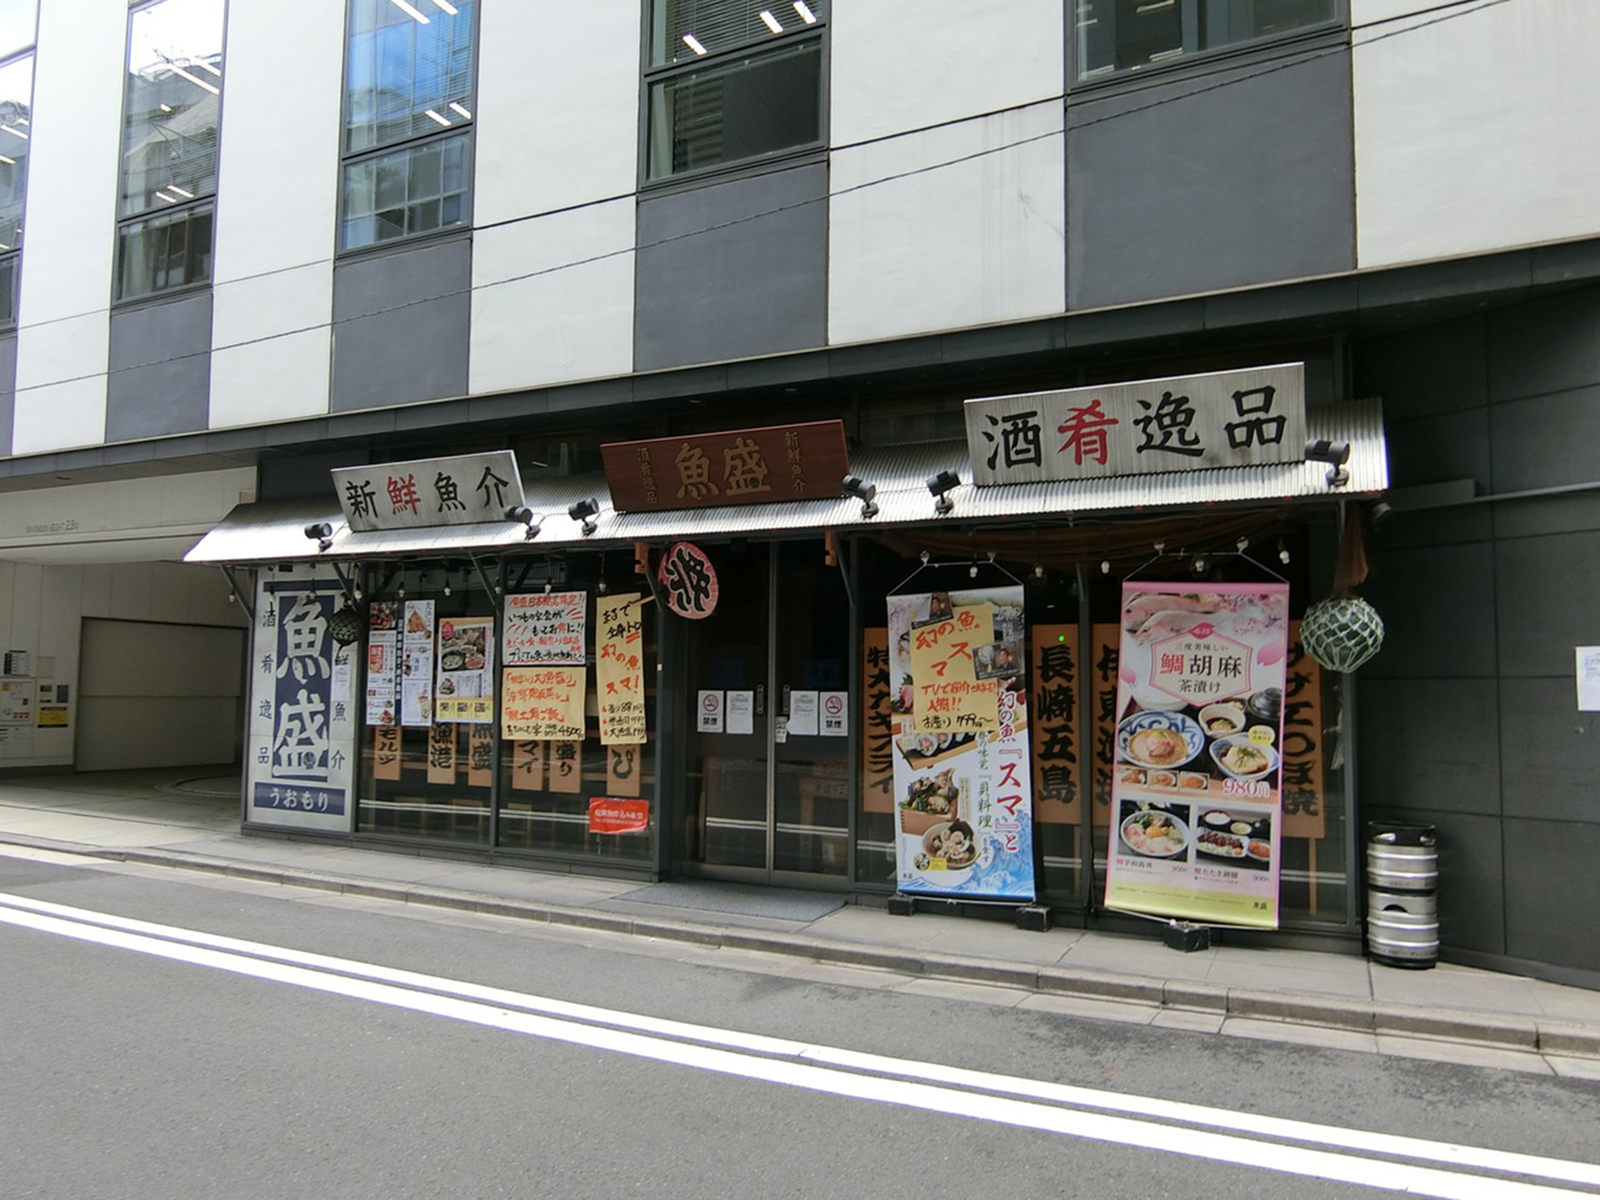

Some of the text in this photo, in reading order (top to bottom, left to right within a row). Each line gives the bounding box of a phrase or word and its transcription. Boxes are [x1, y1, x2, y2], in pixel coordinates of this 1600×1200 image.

[982, 385, 1287, 470] 酒肴逸品
[637, 448, 657, 502] 酒肴逸品
[675, 437, 772, 499] 魚盛
[785, 431, 806, 494] 新鮮魚介
[346, 466, 509, 518] 新鮮魚介
[602, 602, 632, 625] まるで
[915, 610, 980, 650] 幻の魚
[600, 643, 641, 670] 幻の魚
[1160, 653, 1242, 678] 鯛胡麻
[258, 601, 276, 765] 酒肴逸品
[273, 595, 330, 777] 魚盛
[1179, 679, 1221, 694] 茶漬け
[1036, 644, 1077, 804] 長崎五島
[270, 788, 329, 812] うおもり
[1223, 778, 1271, 798] 980円
